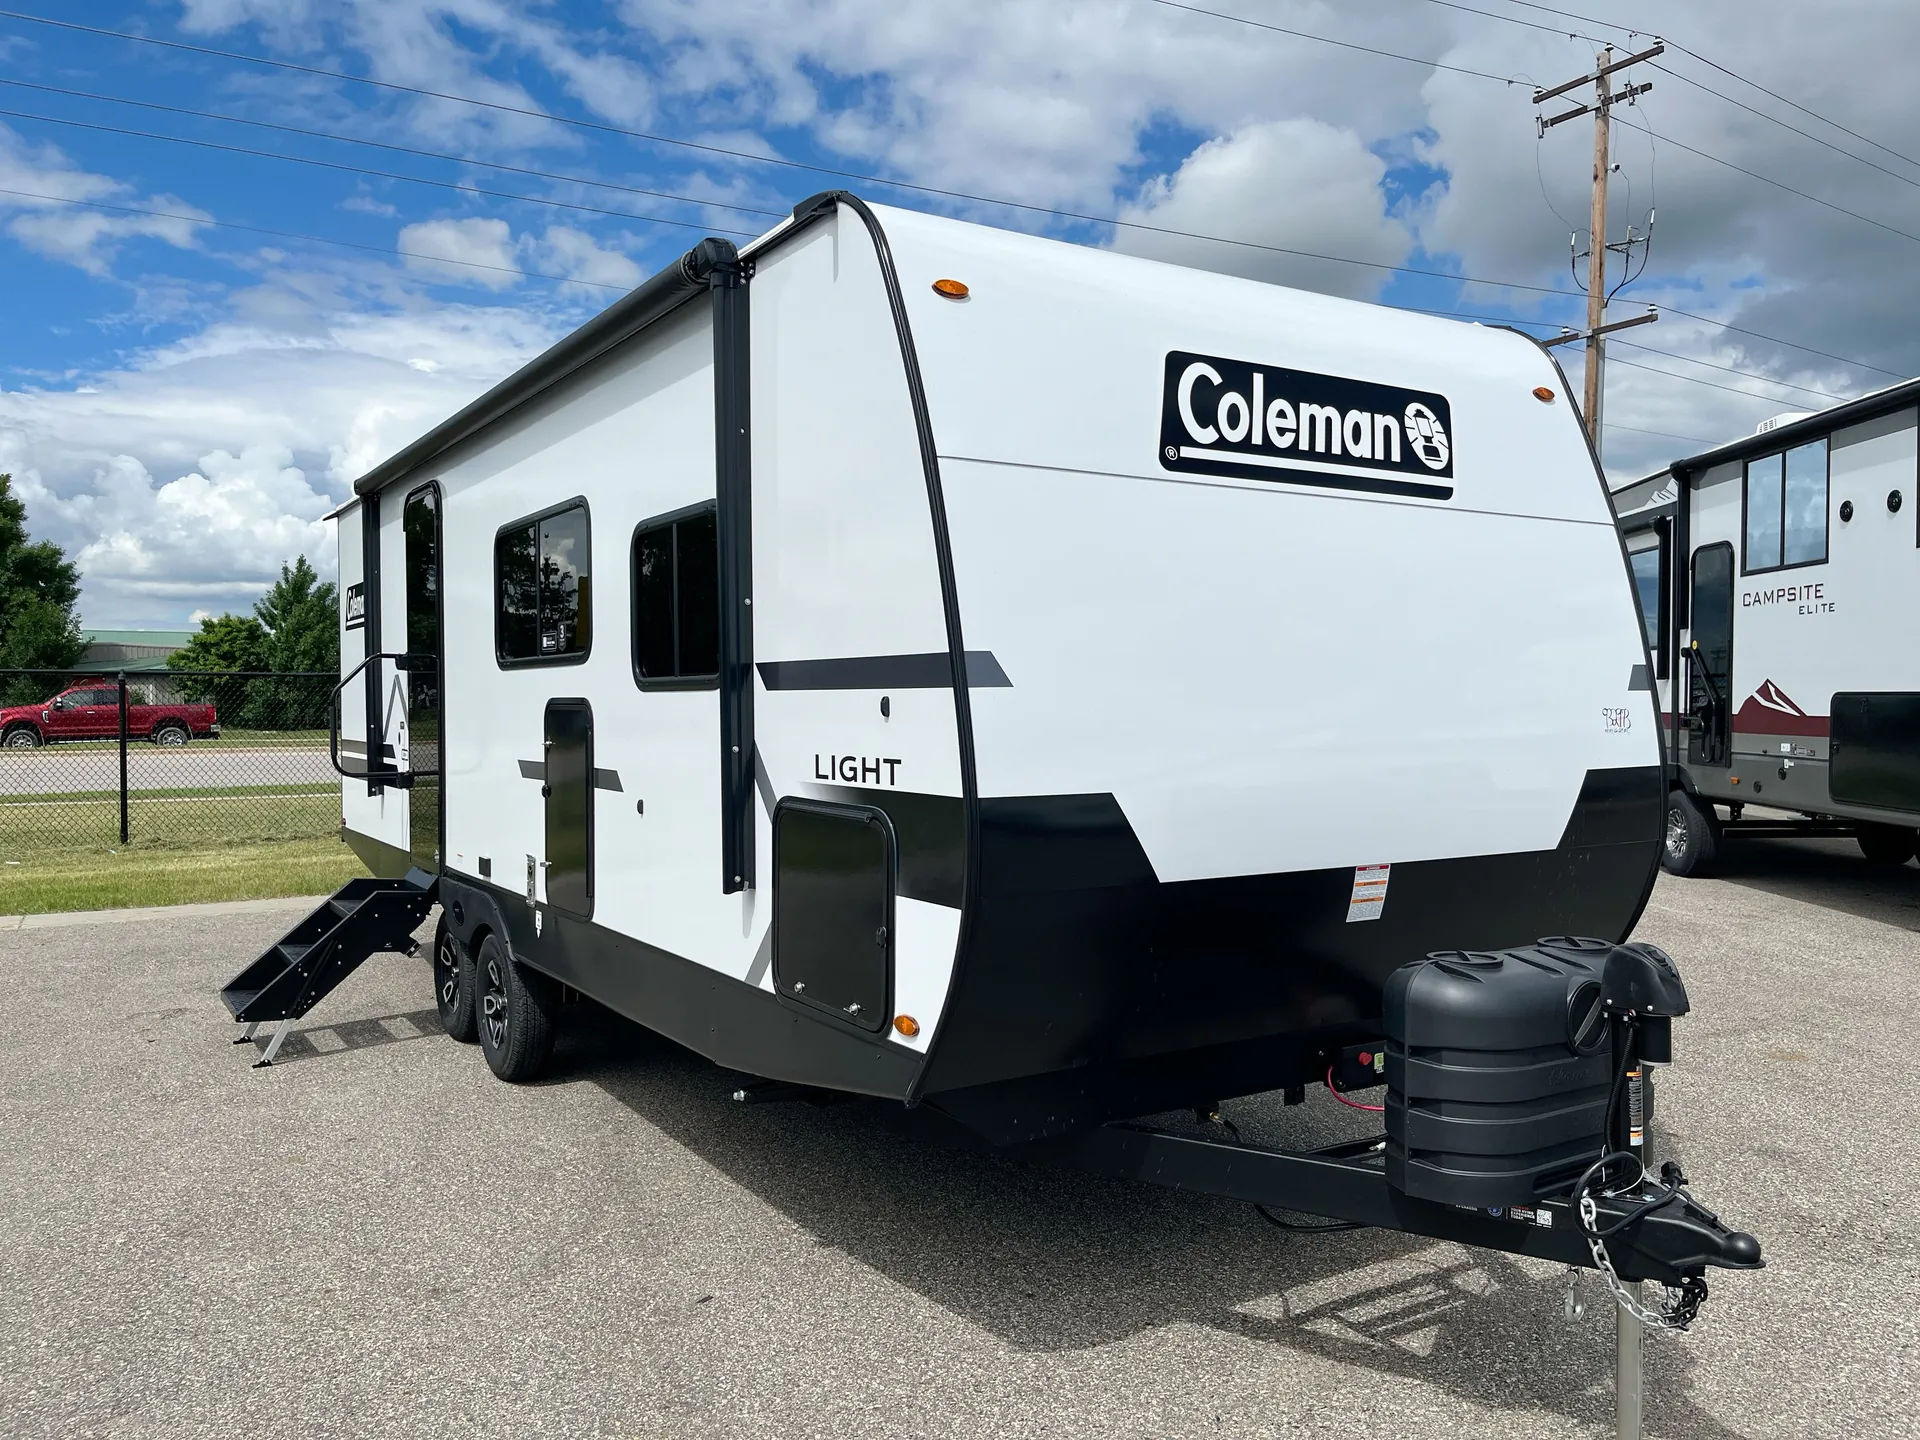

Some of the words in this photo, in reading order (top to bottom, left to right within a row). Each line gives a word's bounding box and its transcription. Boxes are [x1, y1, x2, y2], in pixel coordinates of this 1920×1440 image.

[1177, 361, 1401, 463] Coleman
[1743, 583, 1824, 607] CAMPSITE
[1798, 602, 1835, 615] ELITE
[815, 754, 902, 786] LIGHT
